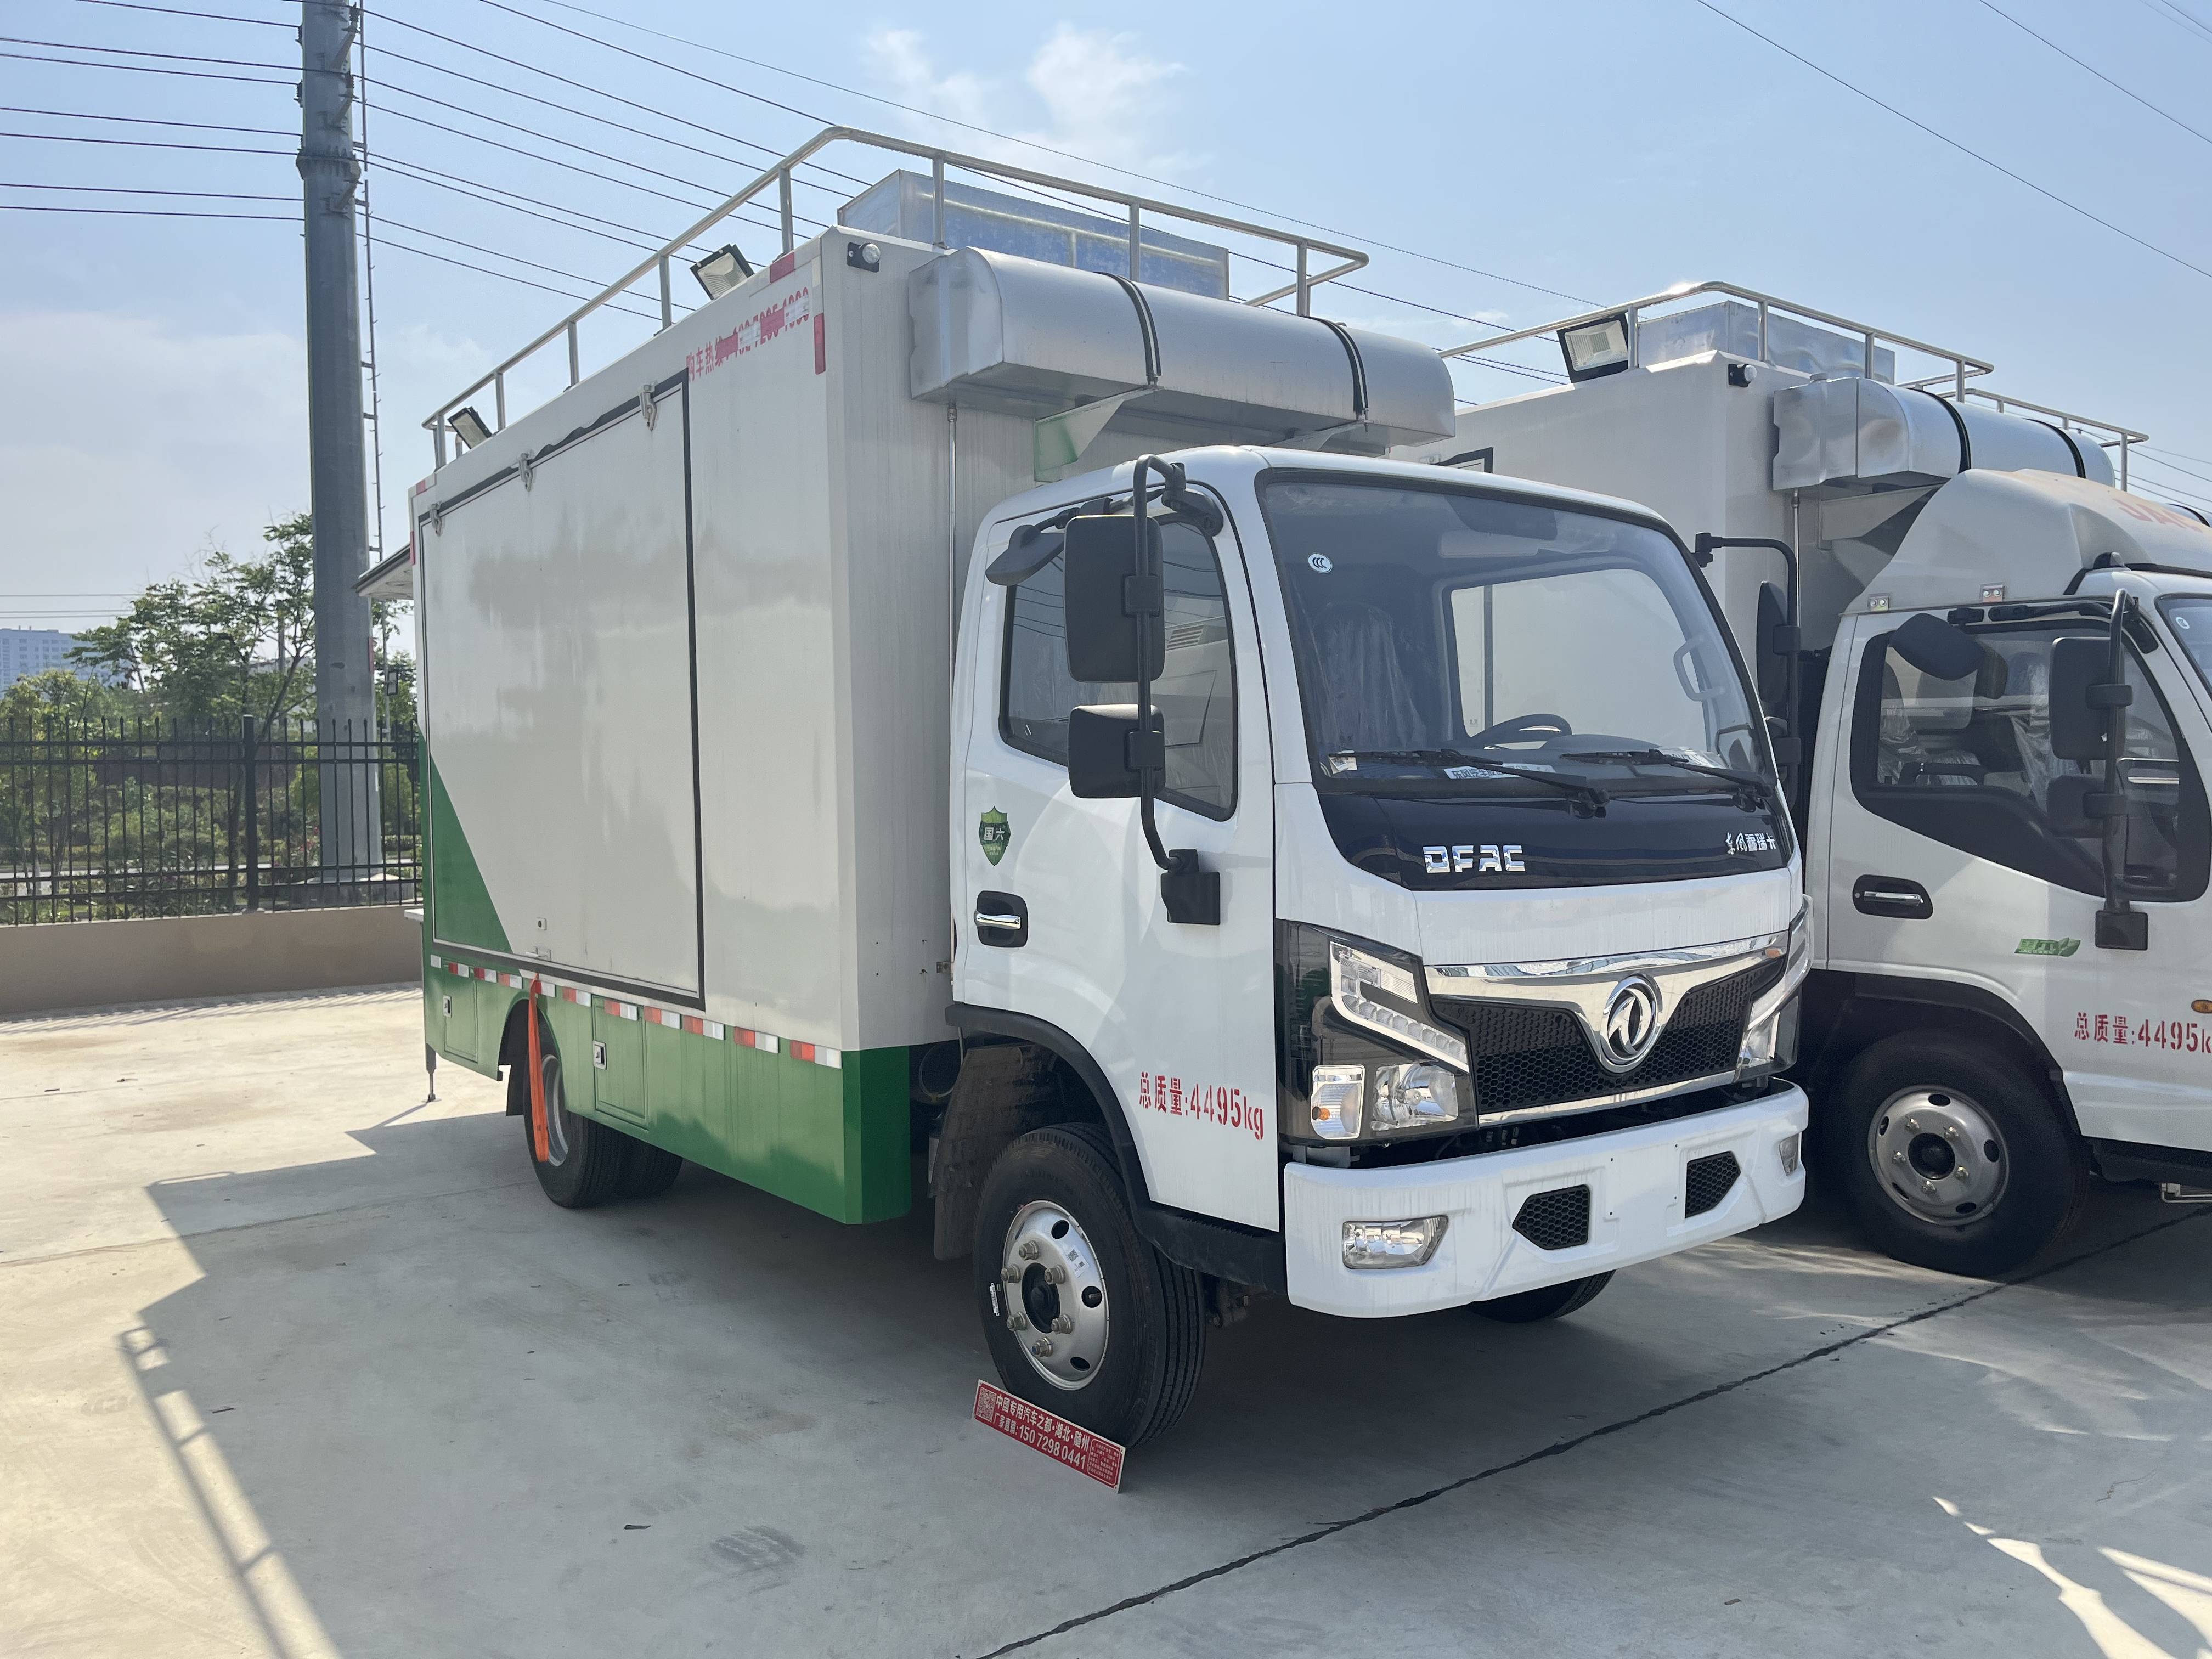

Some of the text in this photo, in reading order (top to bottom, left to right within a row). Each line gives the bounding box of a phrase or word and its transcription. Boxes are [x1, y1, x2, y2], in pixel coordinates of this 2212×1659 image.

[984, 827, 1005, 841] 国六
[1423, 845, 1526, 873] DFAC
[1139, 1071, 1264, 1141] 总质量:4495kg
[1037, 1432, 1060, 1457] 7298
[1062, 1445, 1086, 1470] 0441
